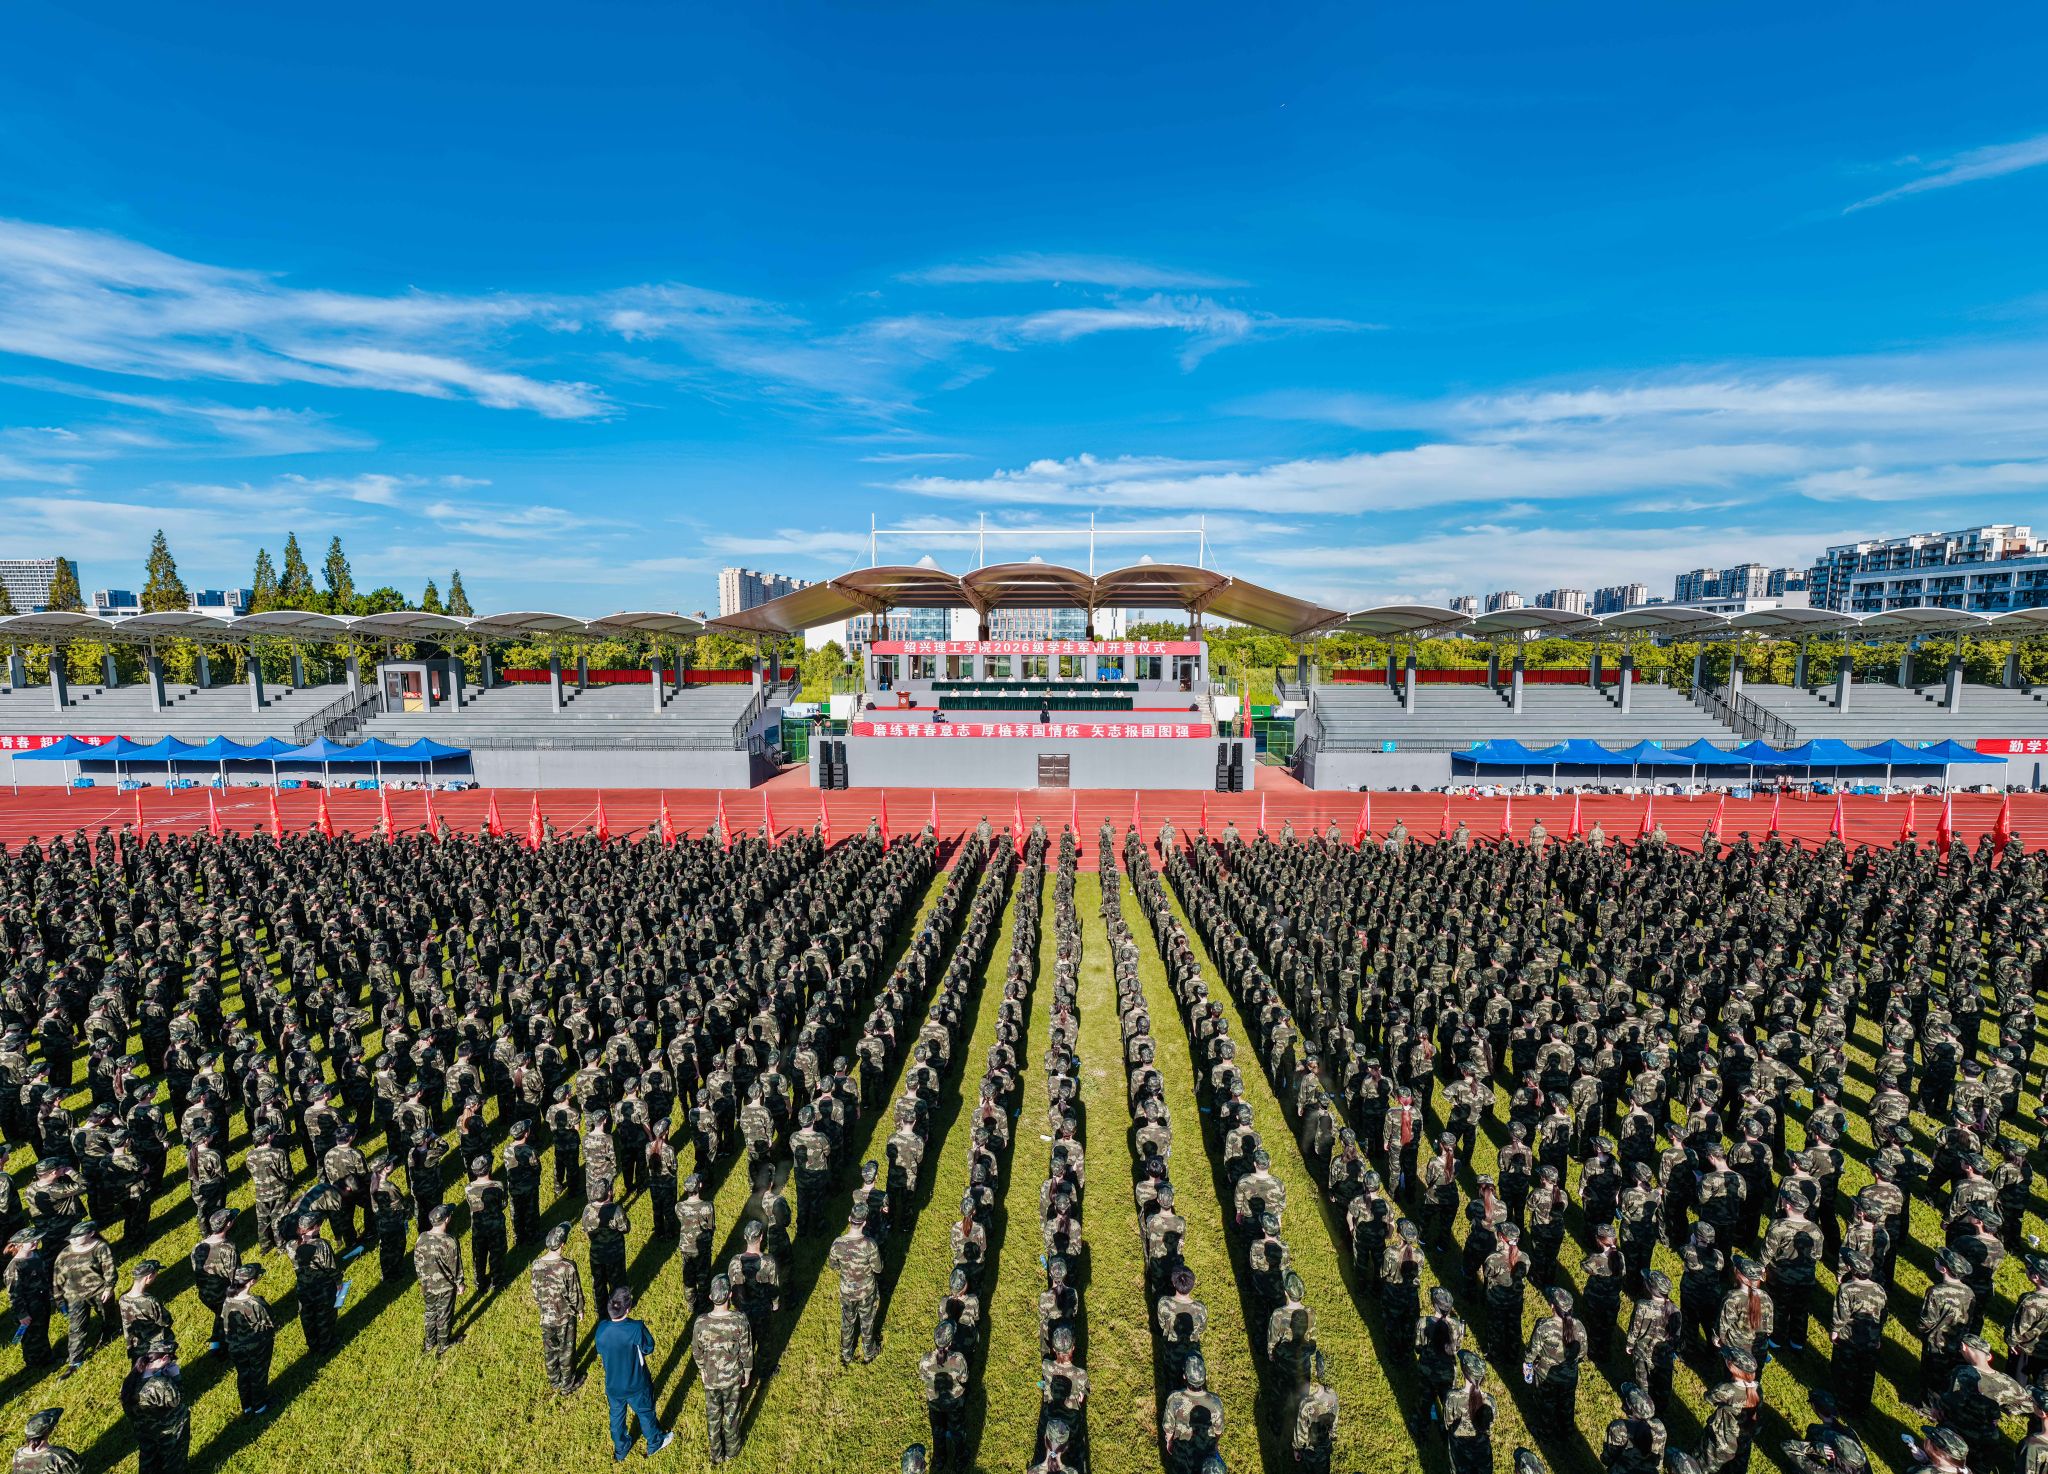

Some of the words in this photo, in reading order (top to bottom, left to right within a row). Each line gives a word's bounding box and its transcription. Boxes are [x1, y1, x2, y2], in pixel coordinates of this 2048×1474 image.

[902, 641, 1167, 655] 绍兴理工学院2026级学生军训开营仪式
[873, 723, 970, 737] 磨练青春意志
[981, 723, 1079, 737] 厚植家国情怀
[1091, 723, 1190, 738] 矢志报国图强
[40, 736, 102, 748] 超我
[2009, 740, 2048, 753] 勤学
